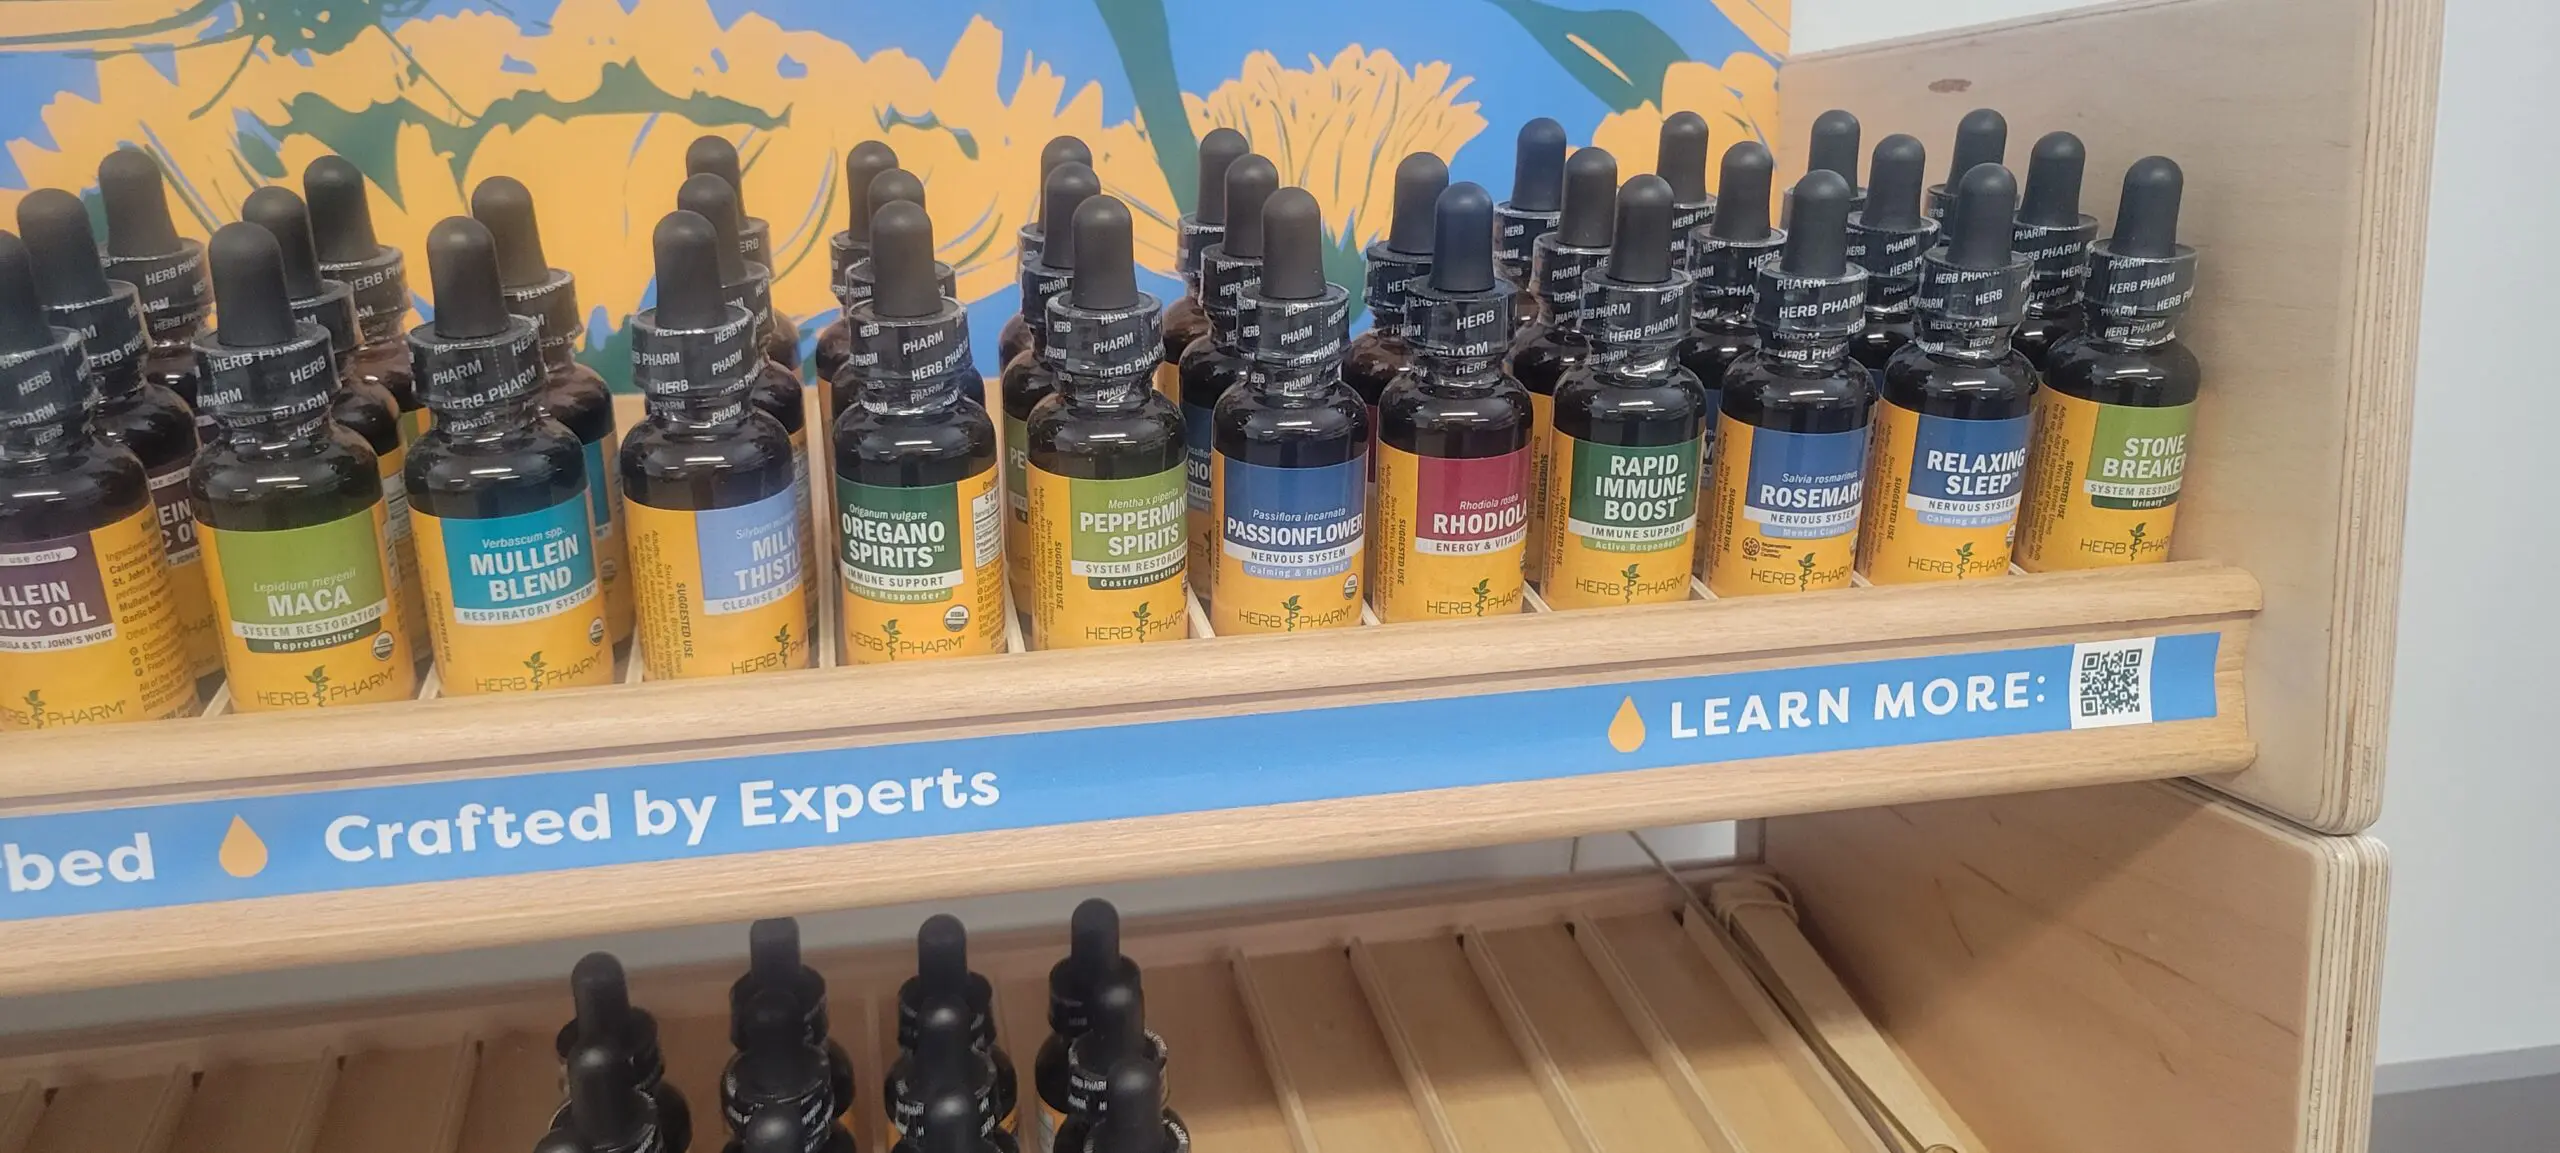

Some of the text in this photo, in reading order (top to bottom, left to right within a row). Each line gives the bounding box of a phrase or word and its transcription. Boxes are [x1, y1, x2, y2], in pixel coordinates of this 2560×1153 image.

[1505, 224, 1524, 237] HERB
[1672, 212, 1694, 229] HERB
[1886, 236, 1917, 254] PHARM
[2042, 242, 2081, 260] PHARM
[145, 267, 177, 285] HERB
[1552, 265, 1580, 281] PHARM
[2140, 272, 2175, 291] PHARM
[1039, 278, 1068, 294] PHARM
[1779, 292, 1864, 319] HERB PHARM
[1976, 289, 2002, 306] HERB
[860, 323, 879, 338] HERB
[1054, 322, 1071, 333] HERB
[1456, 310, 1495, 331] HERB
[1609, 314, 1679, 343] HERB PHARM
[903, 331, 944, 355] PHARM
[1093, 332, 1134, 354] PHARM
[1281, 325, 1313, 346] PHARM
[212, 353, 253, 373] HERB
[289, 356, 327, 385] HERB
[712, 349, 743, 375] PHARM
[912, 361, 943, 381] HERB
[432, 360, 483, 386] PHARM
[488, 365, 537, 401] PHARM
[657, 380, 689, 394] HERB
[2124, 434, 2186, 458] STONE
[1610, 454, 1679, 476] RAPID
[1927, 448, 2025, 473] RELAXING
[1595, 473, 1687, 499] IMMUNE
[1782, 471, 1858, 483] Salvia rosmarinus
[1760, 478, 1864, 508] ROSEMARY
[2057, 460, 2073, 519] SUGGESTED USE
[2090, 485, 2134, 495] SYSTEM
[1108, 499, 1144, 509] Mentha
[1146, 497, 1150, 505] x
[1460, 493, 1519, 510] Rhodiola rosea
[1887, 477, 1901, 541] SUGGESTED USE
[1929, 499, 2014, 512] NERVOUS SYSTEM
[850, 503, 927, 522] Origanum vulgare
[1253, 507, 1345, 522] Passiflora incarnata
[1433, 499, 1527, 534] RHODIOLA
[1726, 488, 1736, 536] SUGGESTED
[1771, 509, 1855, 524] NERVOUS SYSTEM
[843, 513, 945, 544] OREGANO
[1228, 513, 1363, 546] PASSIONFLOWER
[1558, 497, 1566, 548] SUGGESTED
[1592, 523, 1684, 538] IMMUNE SUPPORT
[482, 527, 565, 549] Verbascum spp.
[752, 523, 795, 561] MILK
[1108, 523, 1179, 556] SPIRITS
[1398, 519, 1406, 569] SUGGESTED
[1437, 542, 1480, 552] ENERGY
[1485, 542, 1490, 550] &
[1595, 543, 1625, 551] Active
[2080, 538, 2126, 554] HERB
[470, 534, 579, 576] MULLEIN
[1086, 543, 1187, 574] SYSTEM RESTORATI
[1251, 548, 1345, 563] NERVOUS SYSTEM
[1908, 556, 1953, 573] HERB
[735, 544, 800, 592] THISTL
[1055, 541, 1063, 591] SUGGESTED
[1250, 565, 1290, 578] Calming
[489, 567, 572, 602] BLEND
[848, 569, 944, 587] IMMUNE SUPPORT
[1751, 568, 1795, 585] HERB
[254, 580, 308, 594] Lepidium
[1576, 578, 1619, 596] HERB
[267, 585, 352, 617] MACA
[723, 588, 773, 611] CLEANSE
[1427, 601, 1472, 614] HERB
[50, 602, 96, 627] OIL
[242, 606, 381, 636] SYSTEM RESTORATION
[464, 603, 551, 621] RESPIRATORY
[676, 582, 693, 658] SUGGESTED USE
[1239, 608, 1281, 628] HERB
[48, 632, 83, 648] JOHN'S
[85, 629, 113, 642] WORT
[1086, 626, 1133, 640] HERB
[732, 653, 777, 675] HERB
[476, 677, 527, 692] HERB
[257, 691, 309, 705] HERB
[1671, 671, 2047, 739] LEARN MORE:
[324, 768, 1001, 862] Crafted by Experts
[0, 832, 155, 892] bed
